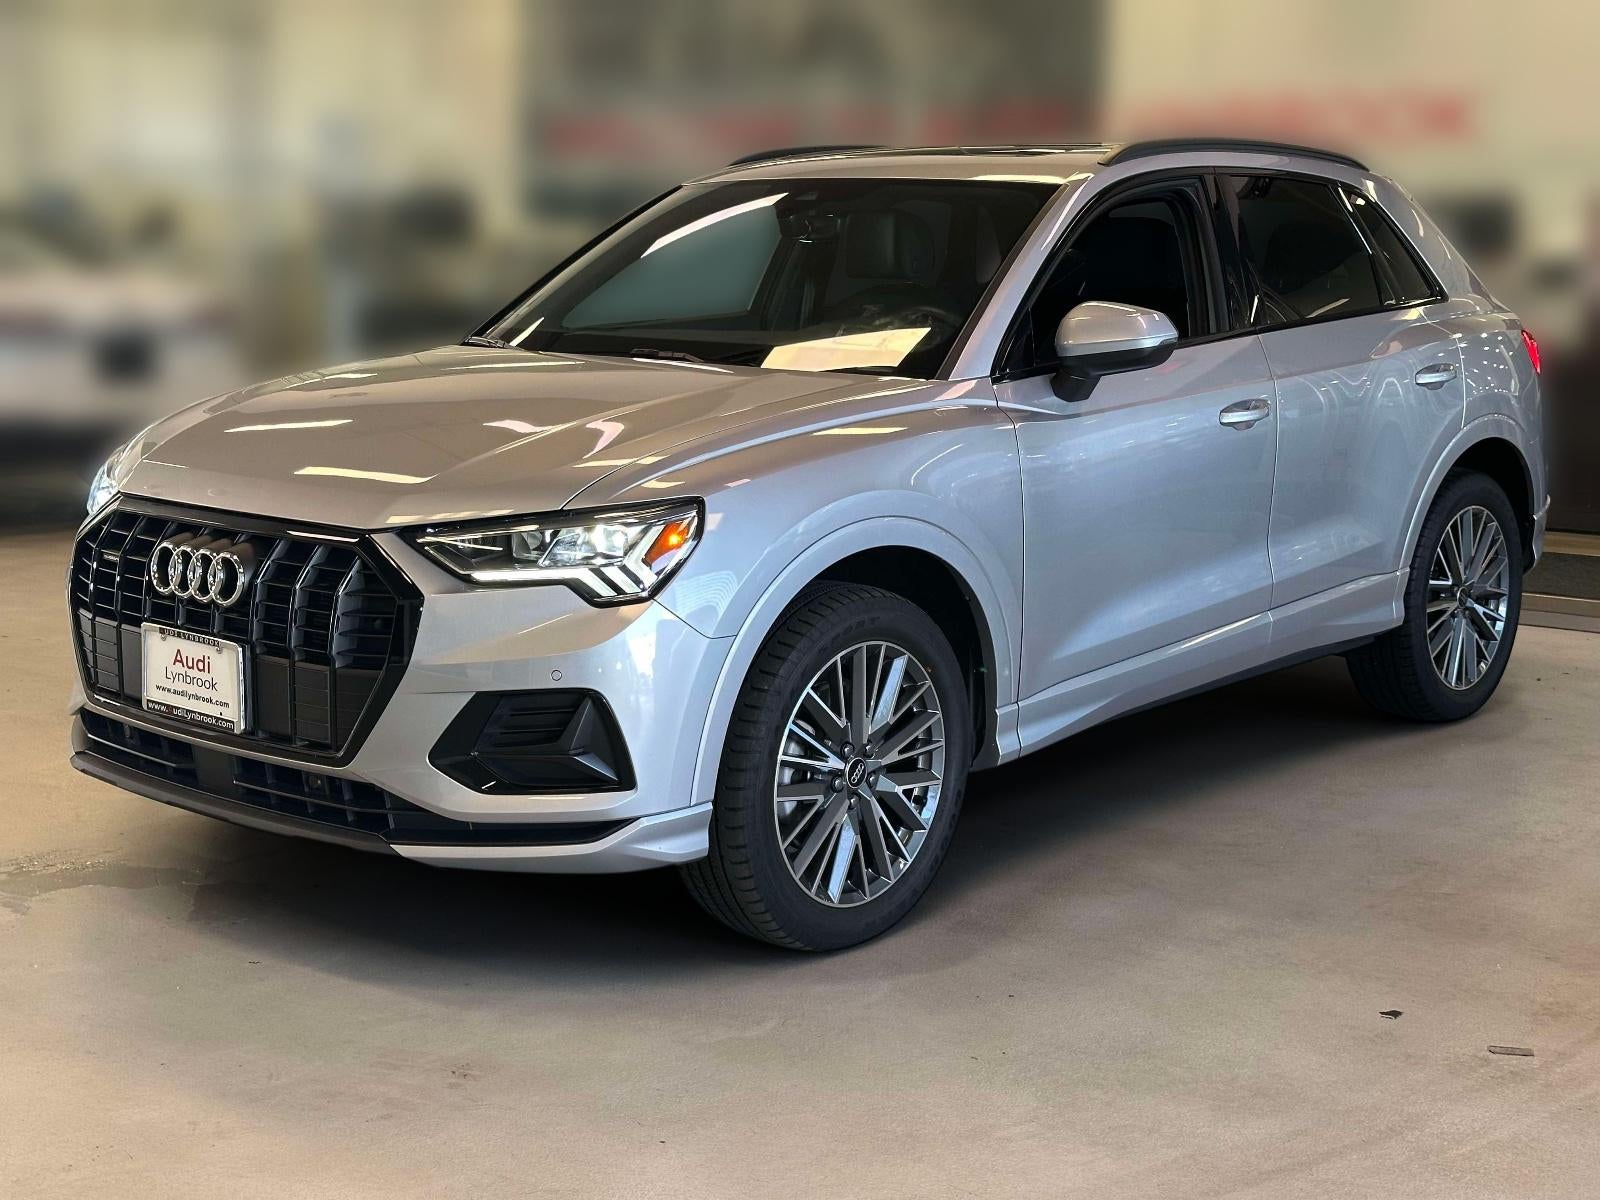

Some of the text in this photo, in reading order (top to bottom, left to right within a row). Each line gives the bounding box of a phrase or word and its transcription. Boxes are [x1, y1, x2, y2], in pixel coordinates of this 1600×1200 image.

[159, 628, 219, 647] UDI LYNBROOK
[173, 649, 211, 674] Audi
[165, 666, 218, 692] Lynbrook
[155, 684, 230, 709] www.audilynbrook.com
